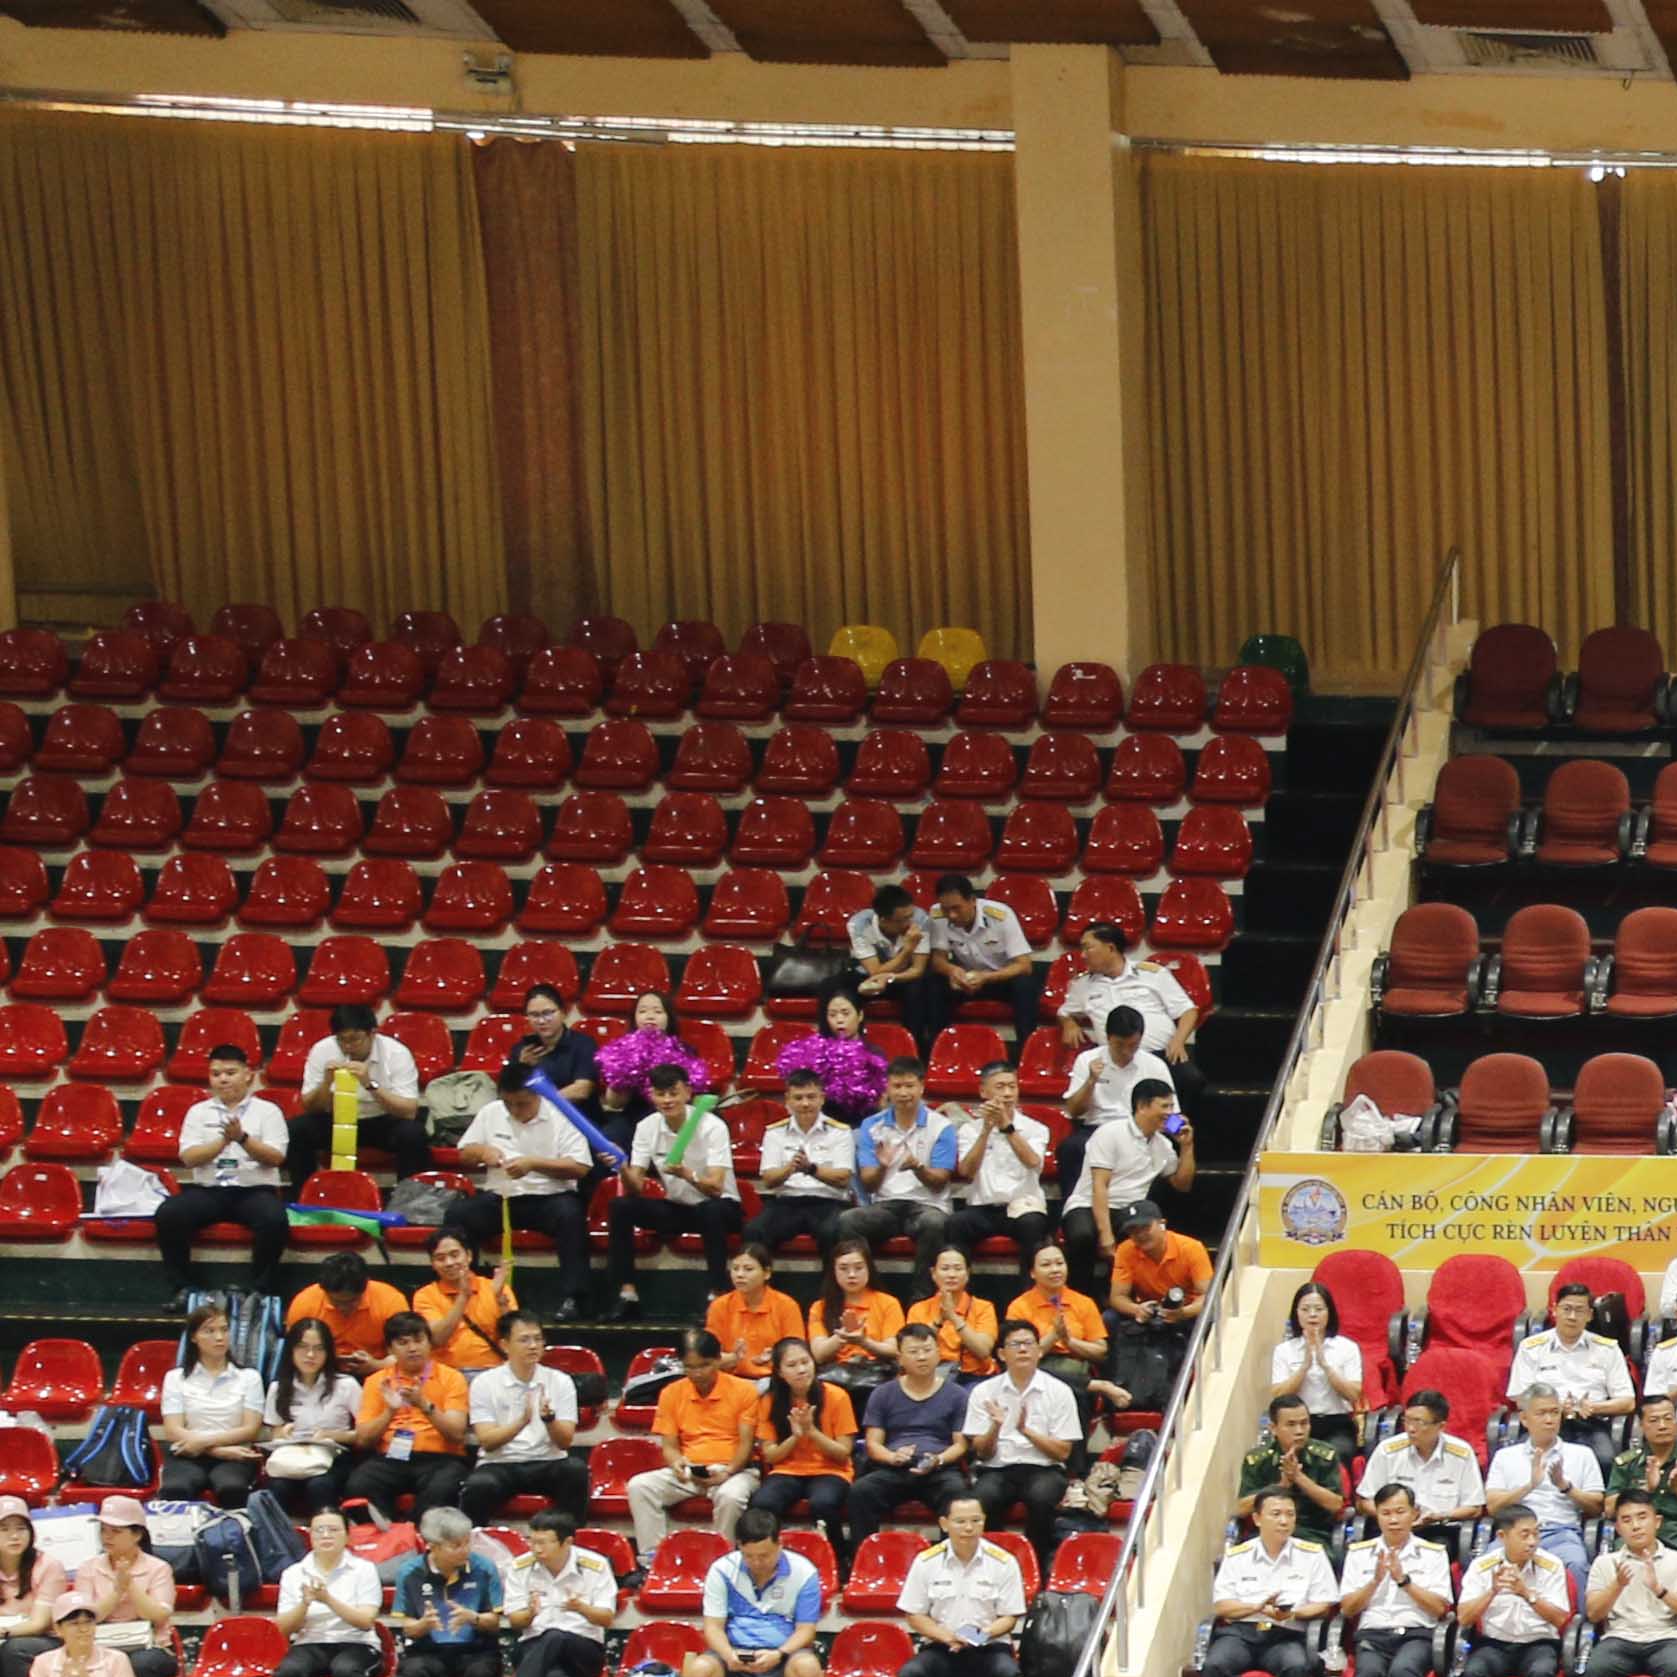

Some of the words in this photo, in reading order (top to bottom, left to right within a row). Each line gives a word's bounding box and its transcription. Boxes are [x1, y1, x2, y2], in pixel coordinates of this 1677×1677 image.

[1411, 1190, 1445, 1213] BỘ,
[1450, 1190, 1509, 1211] CÔNG
[1516, 1192, 1575, 1212] NHÂN
[1582, 1192, 1637, 1214] VIÊN,
[1386, 1219, 1436, 1239] TÍCH
[1443, 1223, 1485, 1243] CỰC
[1492, 1221, 1531, 1240] RÈN
[1540, 1221, 1607, 1243] LUYỆN
[1613, 1221, 1673, 1242] THÂN
